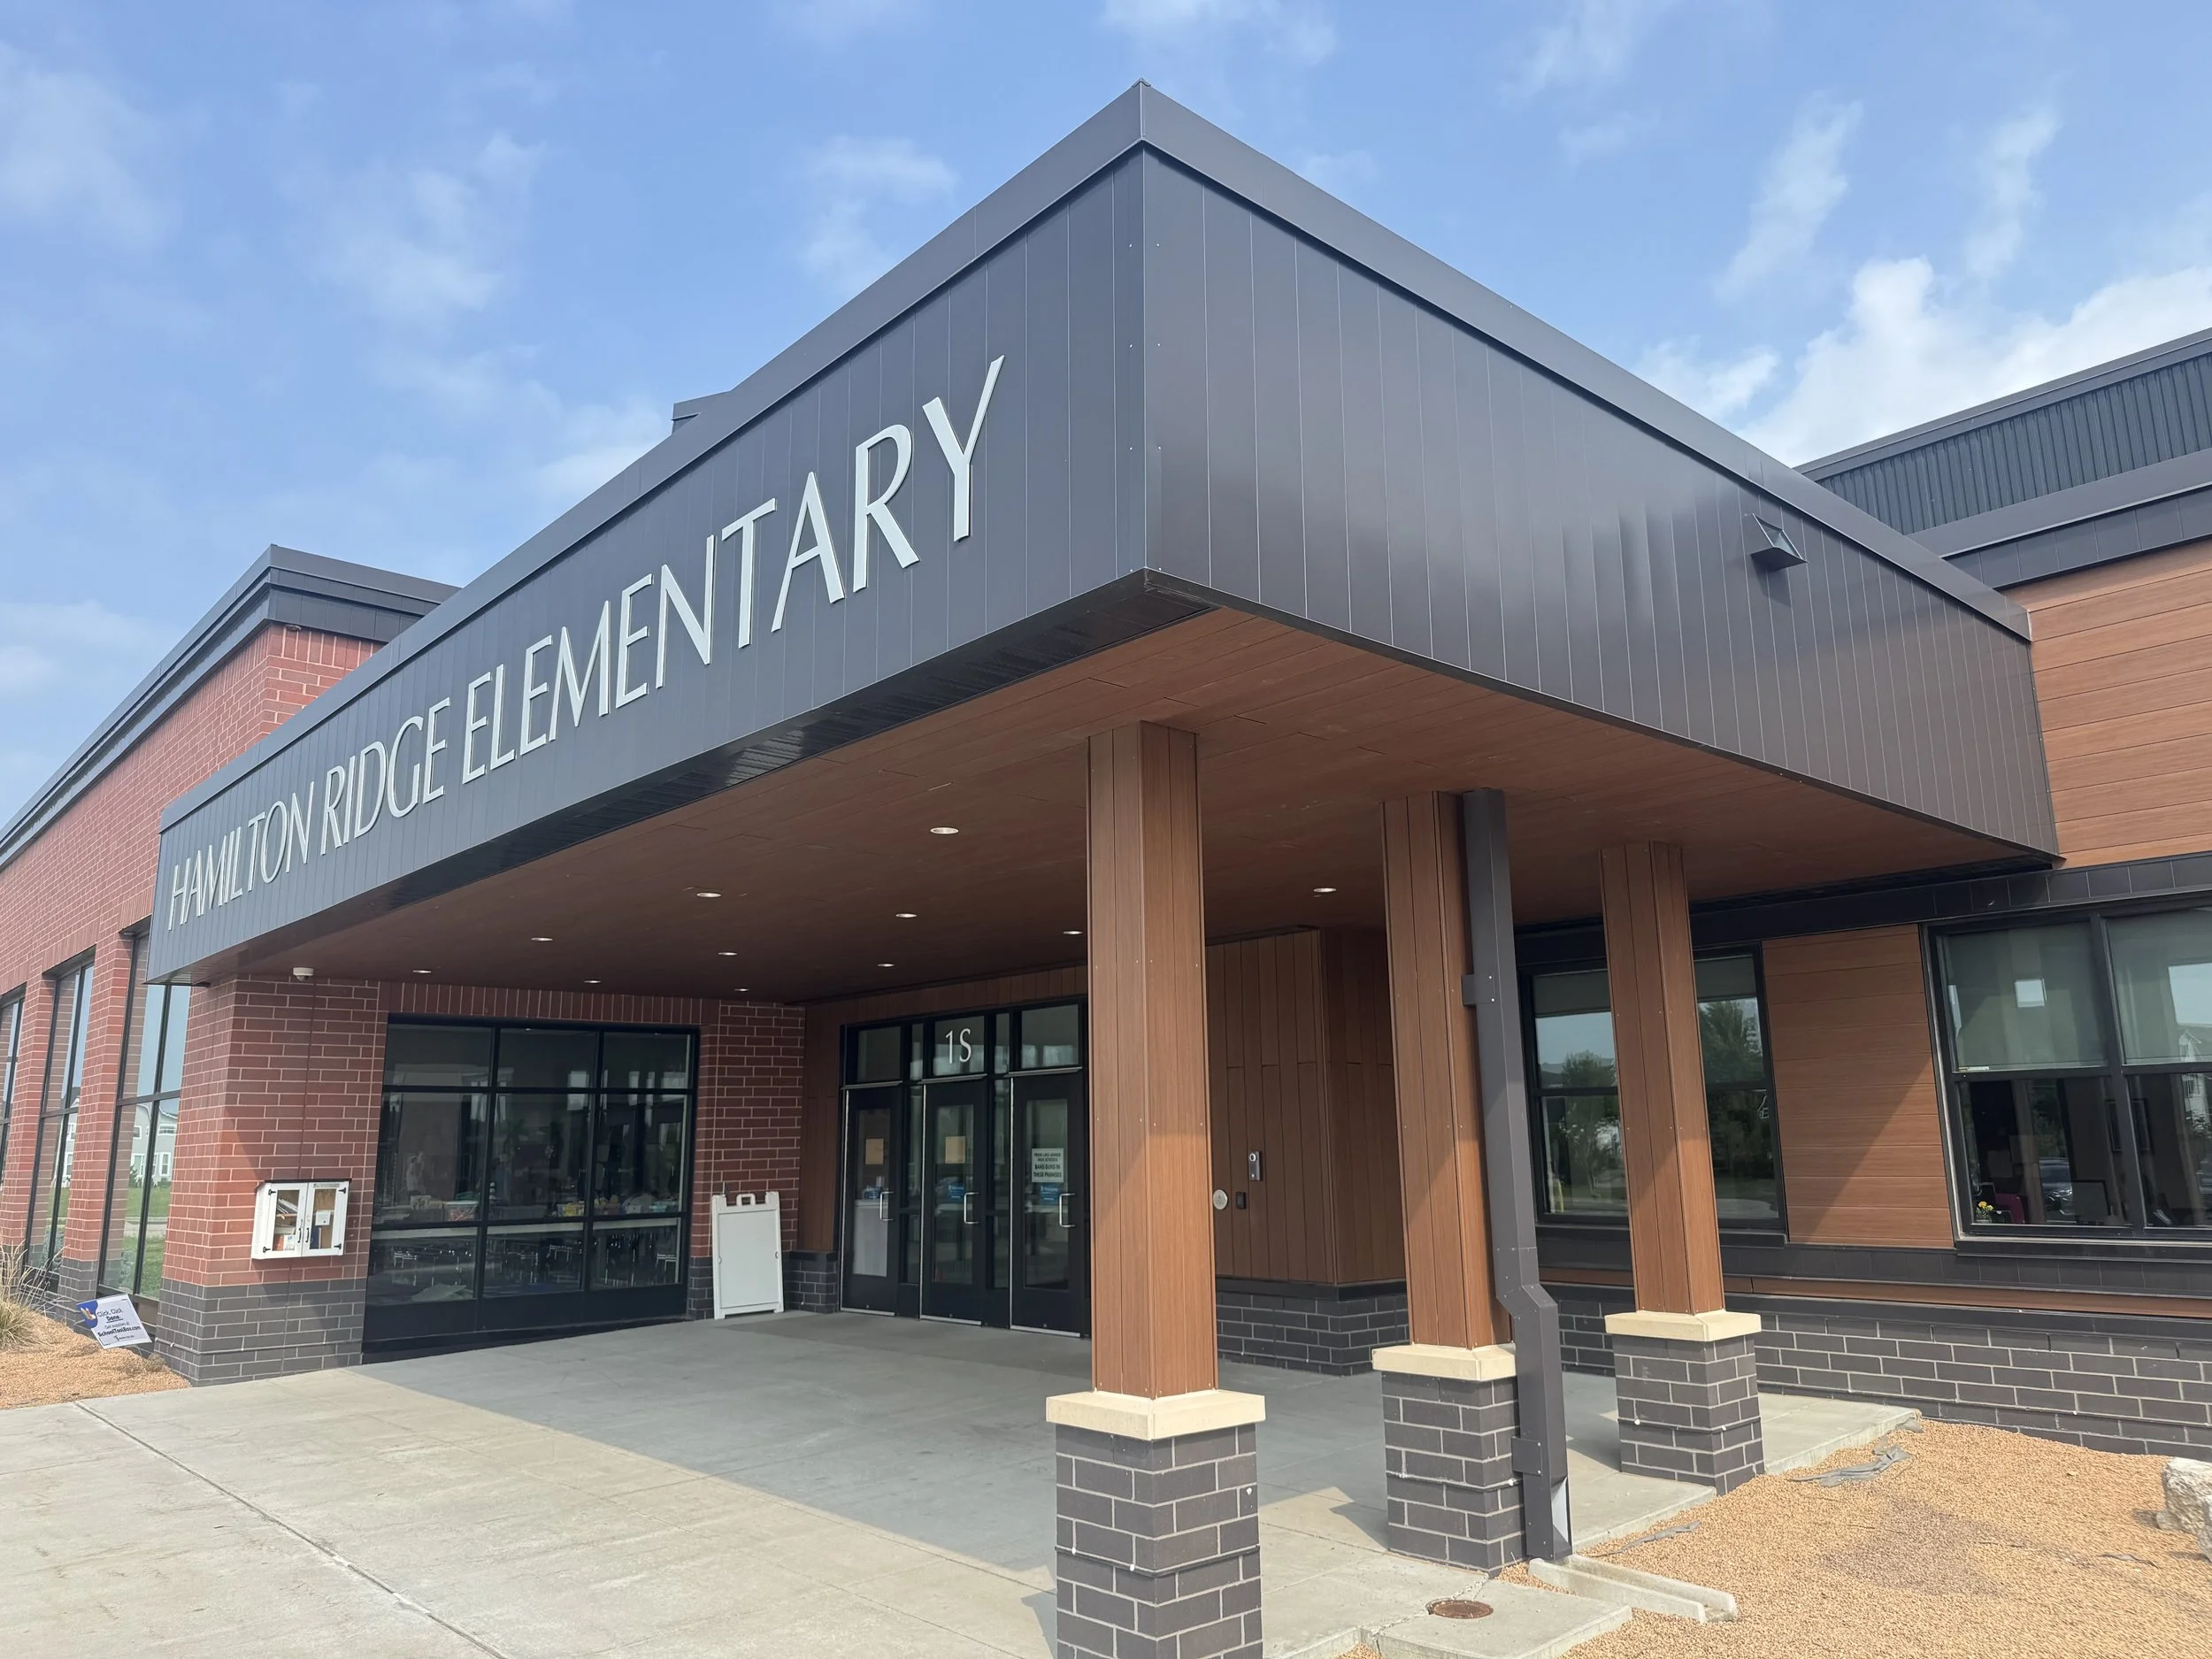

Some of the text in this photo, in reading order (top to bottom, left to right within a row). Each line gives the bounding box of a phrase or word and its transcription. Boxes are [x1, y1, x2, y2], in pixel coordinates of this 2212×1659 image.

[168, 354, 1005, 931] HAMILTON RIDGE ELEMENTARY
[945, 1028, 972, 1064] 1S
